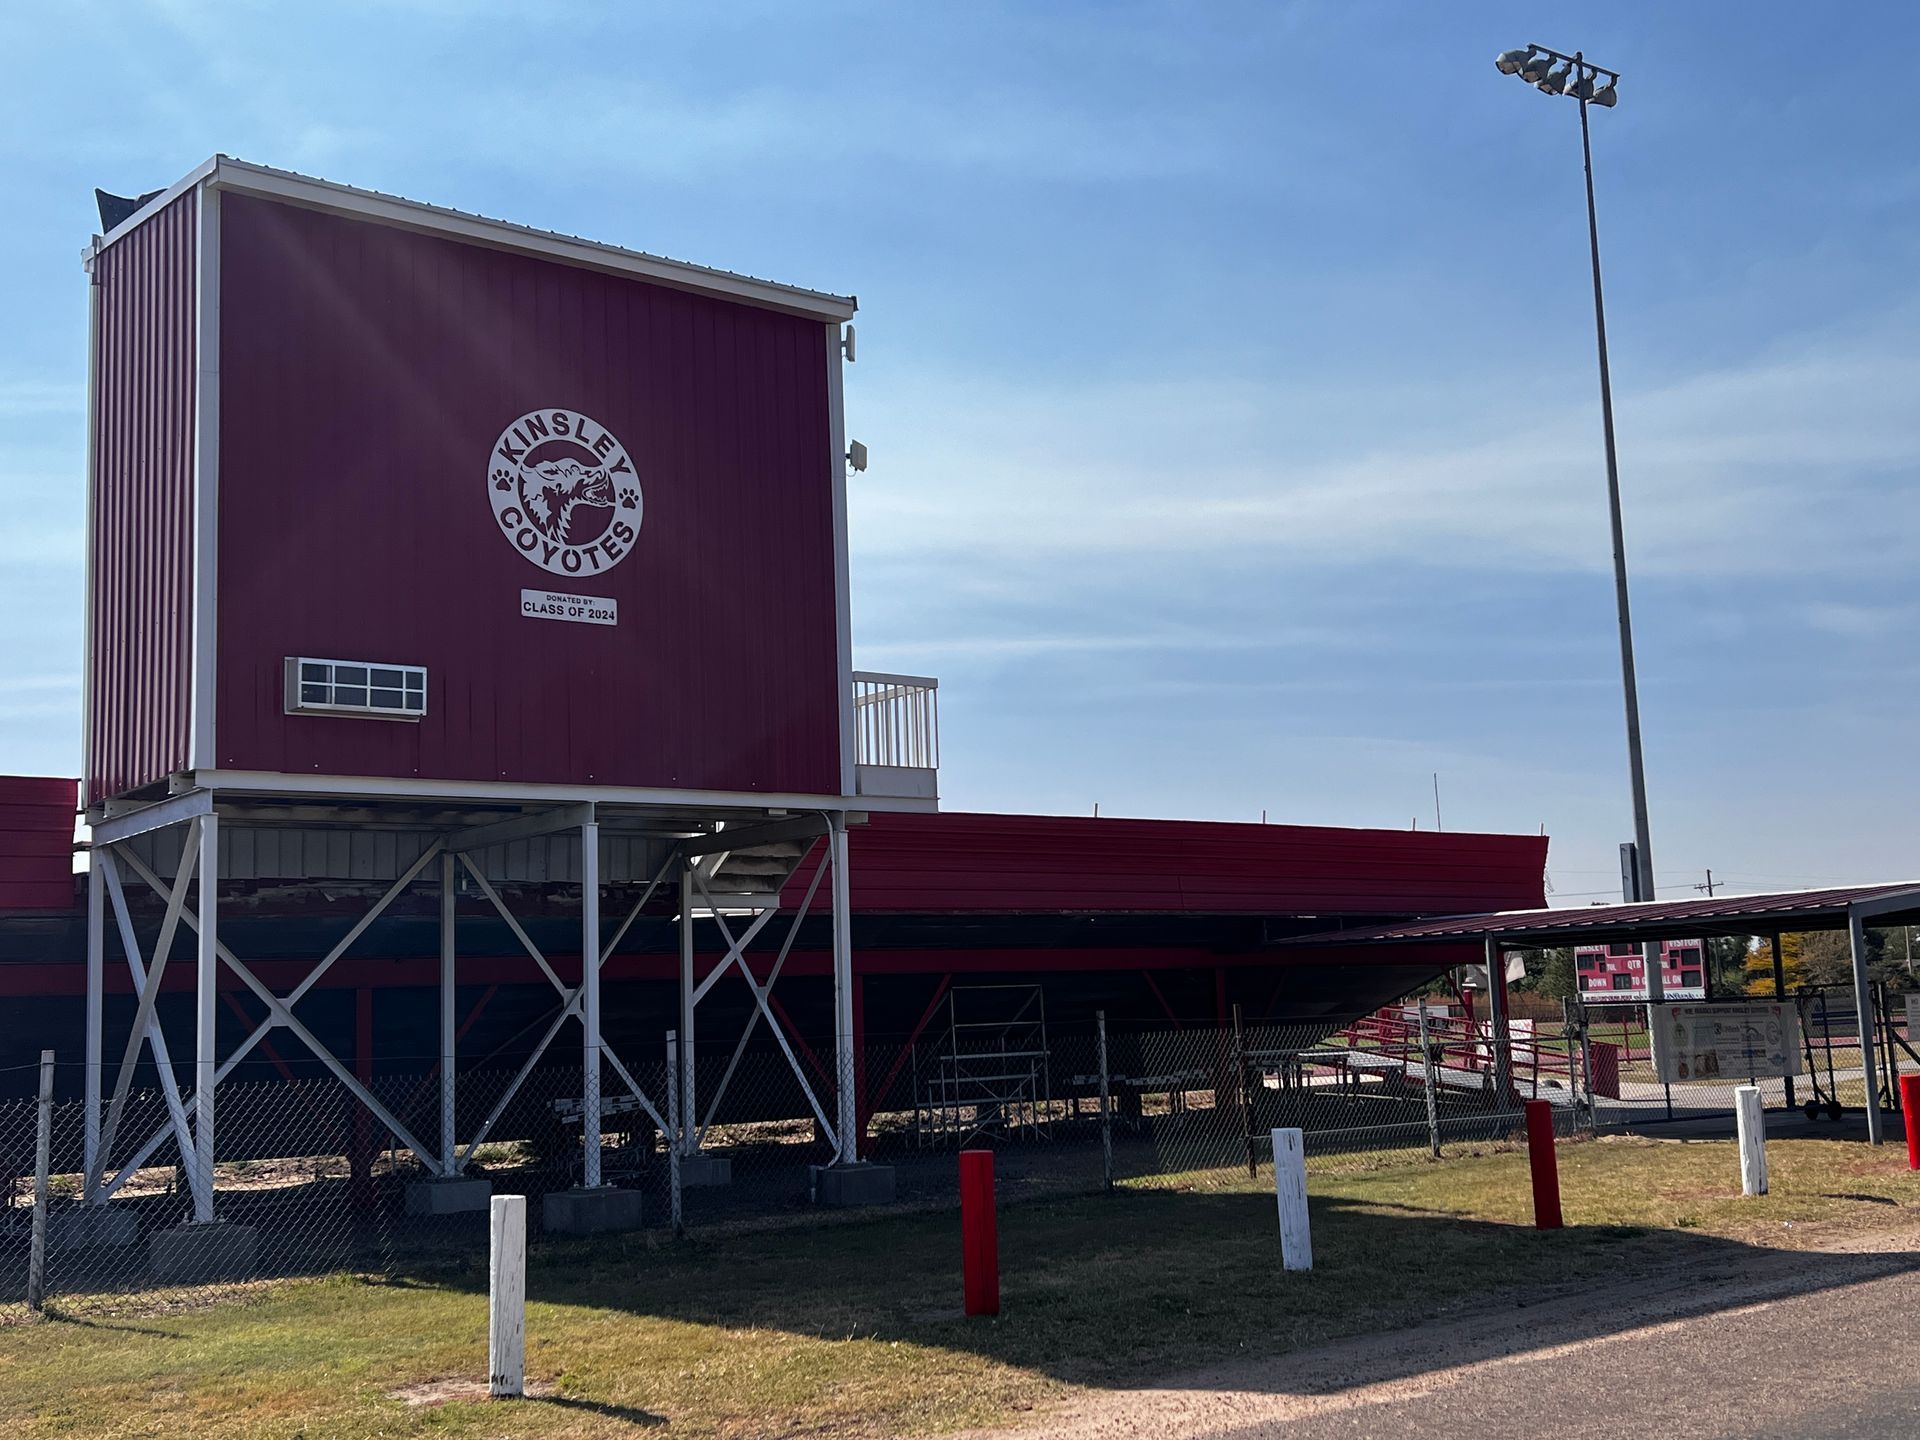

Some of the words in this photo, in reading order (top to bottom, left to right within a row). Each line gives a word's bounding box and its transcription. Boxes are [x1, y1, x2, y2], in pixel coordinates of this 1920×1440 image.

[498, 412, 632, 474] KINSLEY
[500, 506, 634, 573] COYOTES
[546, 594, 581, 604] DONATED
[523, 601, 565, 616] CLASS
[568, 606, 585, 617] OF
[588, 608, 615, 620] 2024
[1627, 959, 1642, 970] QTR
[1588, 978, 1607, 987] DOWN
[1632, 976, 1640, 985] TO
